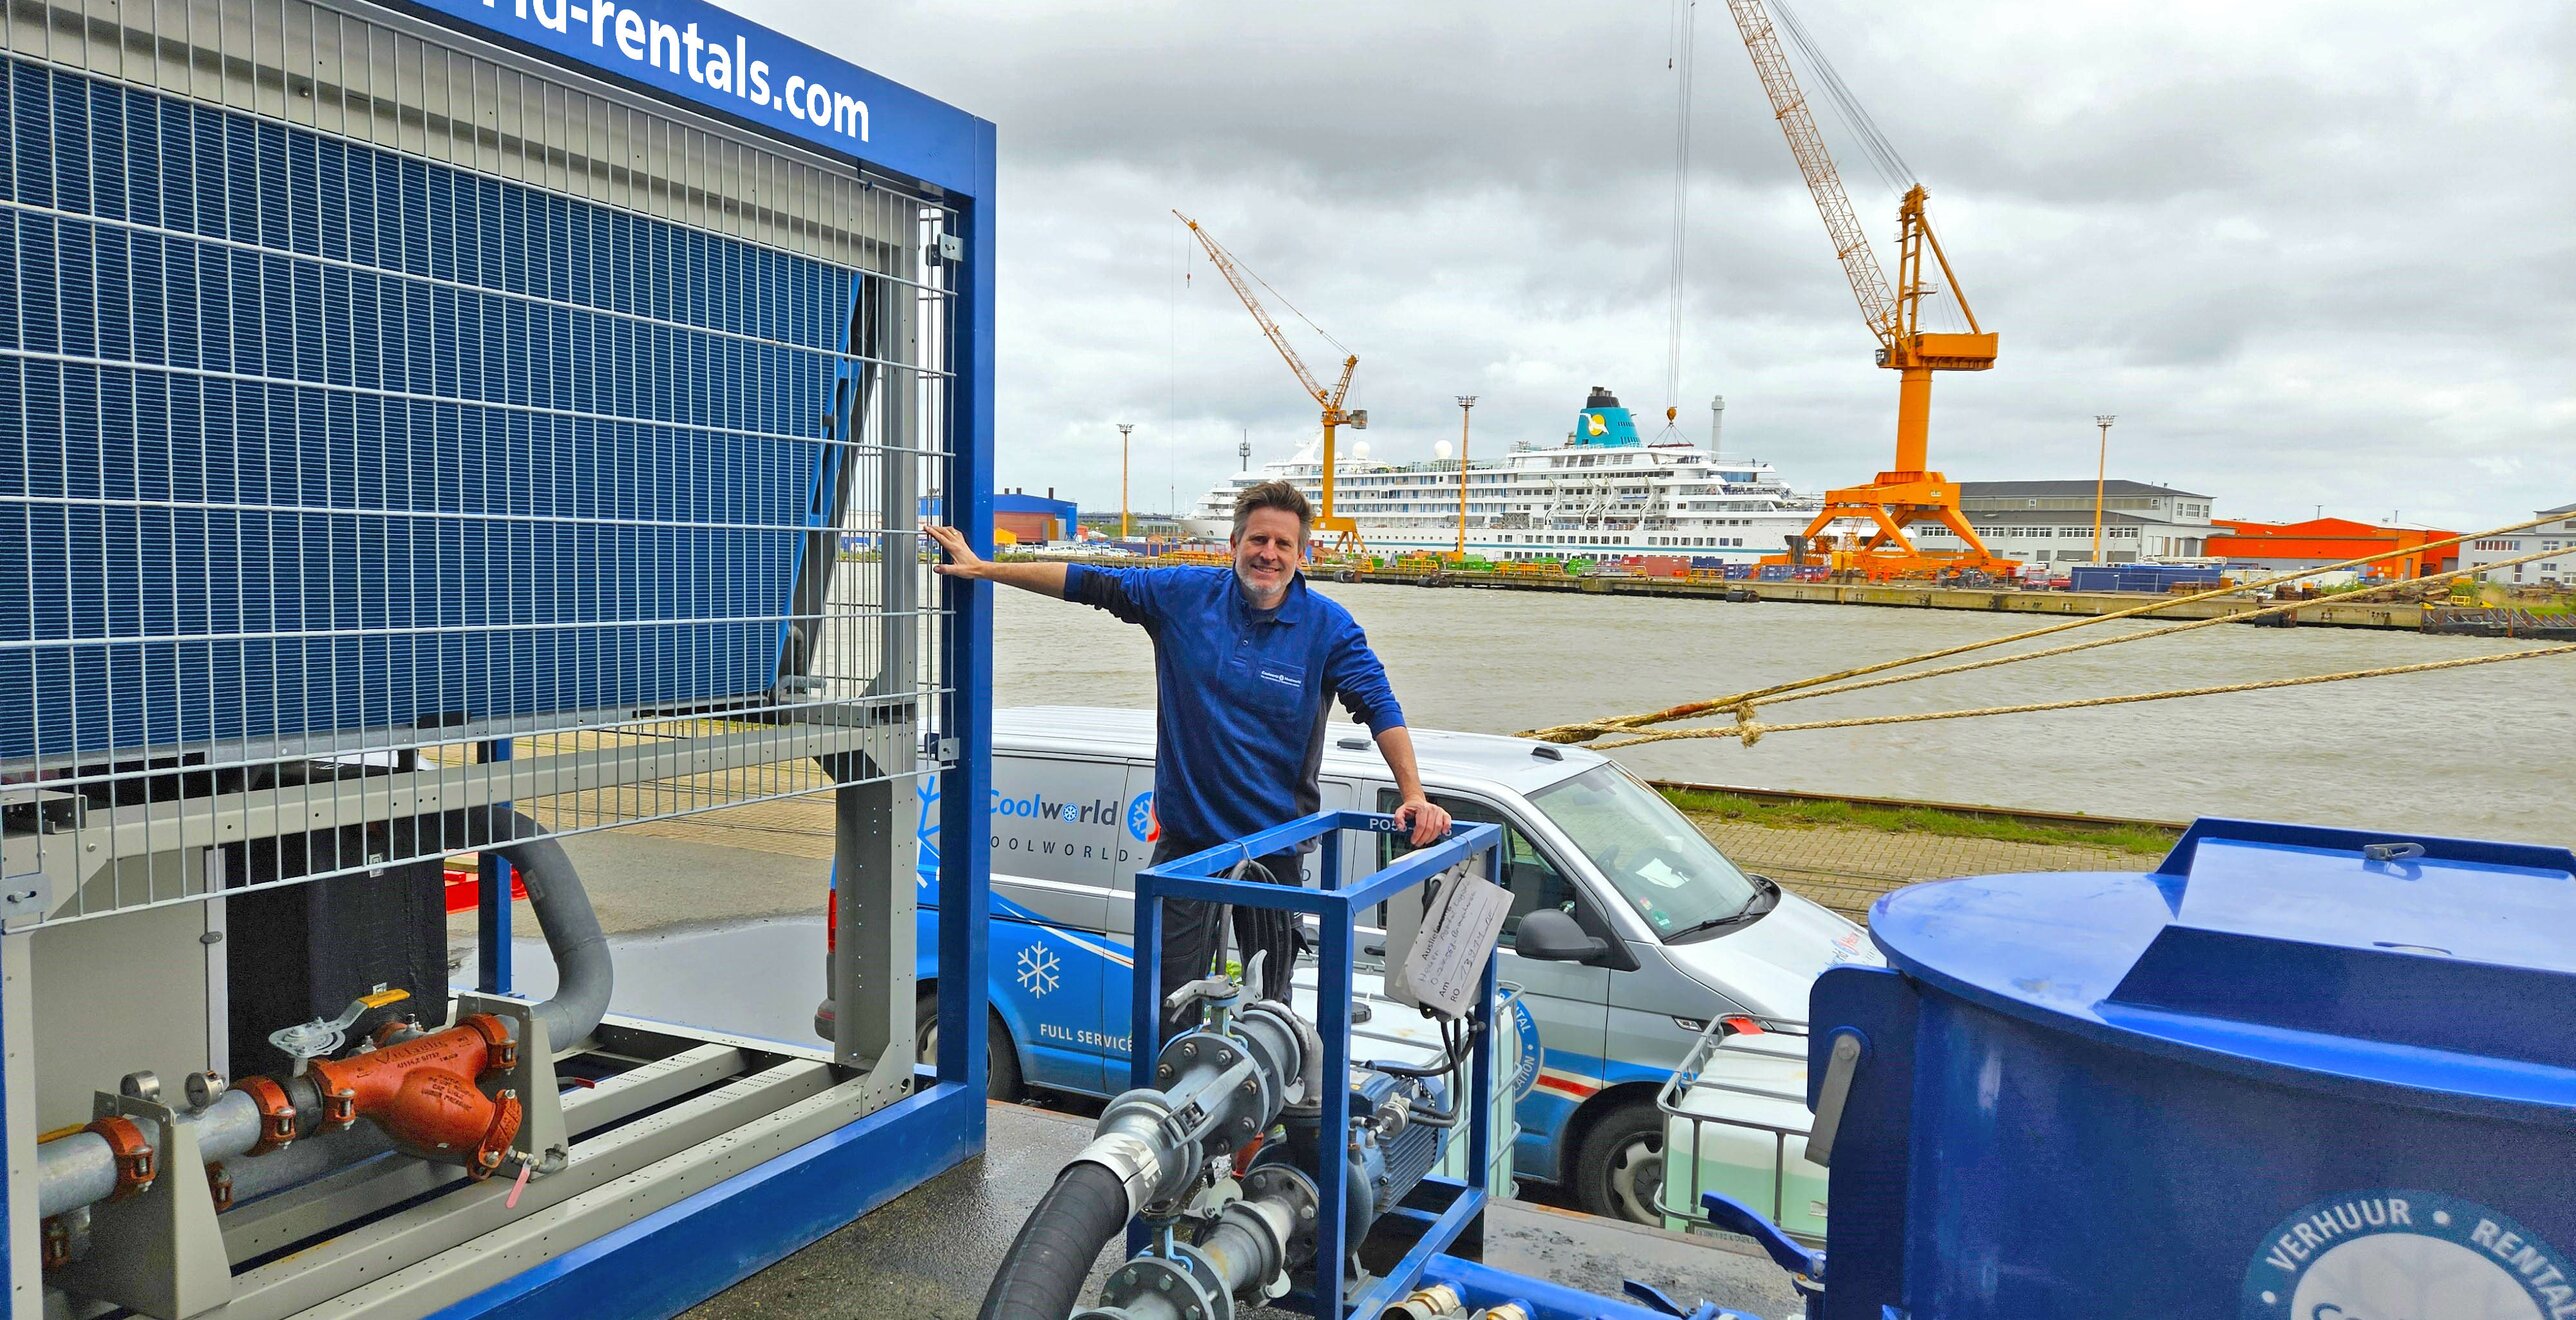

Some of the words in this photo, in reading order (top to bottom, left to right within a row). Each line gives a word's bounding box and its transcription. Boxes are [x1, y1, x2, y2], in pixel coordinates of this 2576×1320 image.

[483, 0, 869, 142] -rentals.com
[1439, 981, 1450, 998] Am
[1450, 987, 1460, 1002] RO
[1040, 1024, 1073, 1040] FULL
[2266, 1199, 2412, 1272] VERHUUR
